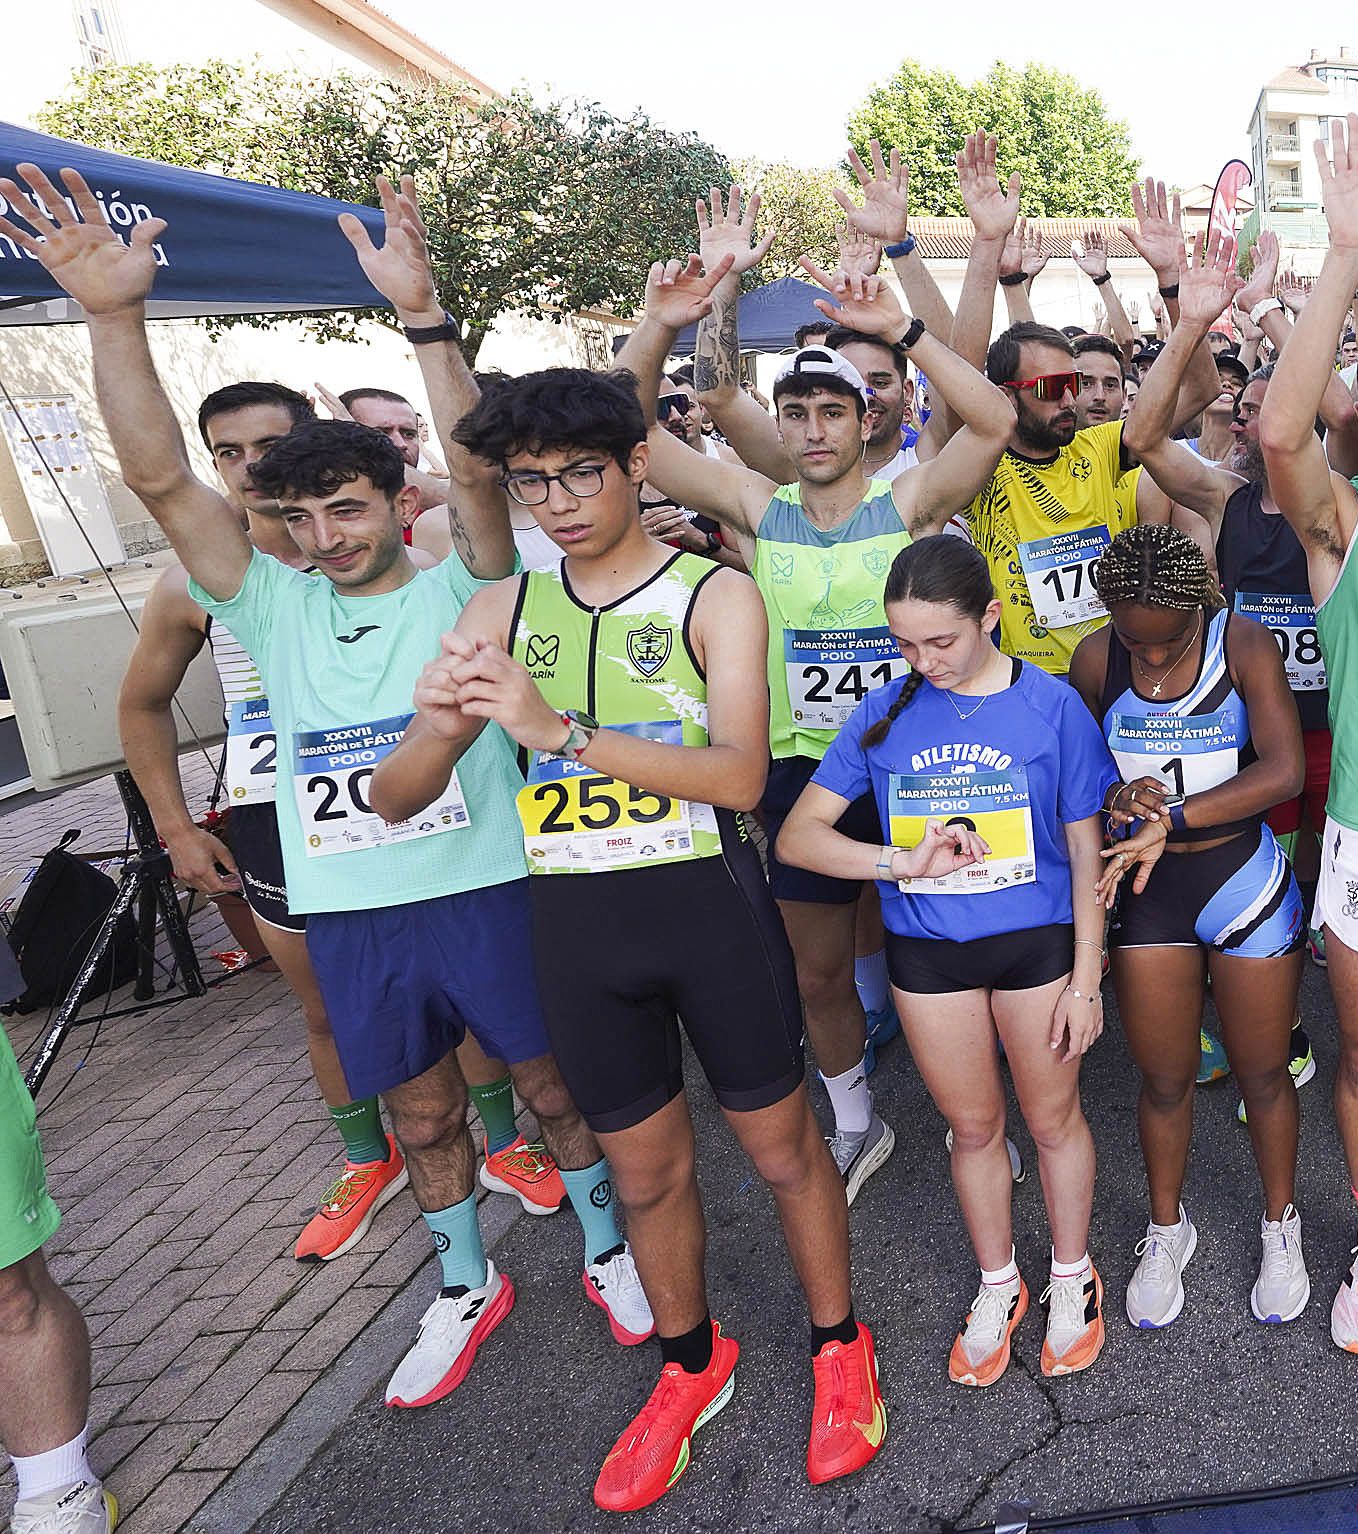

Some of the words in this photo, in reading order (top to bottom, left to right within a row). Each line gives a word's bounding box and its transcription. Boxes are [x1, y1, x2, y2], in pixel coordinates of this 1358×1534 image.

[1051, 534, 1079, 546] XXXVII
[1029, 545, 1066, 560] MARATÓN
[1074, 536, 1104, 549] FÁTIMA
[1054, 552, 1081, 564] POIO
[1240, 604, 1274, 613] MARATÓN
[1284, 604, 1315, 614] FÁTIM
[1260, 615, 1290, 624] POIO
[820, 632, 856, 640] XXXVII
[793, 639, 837, 650] MARATÓN
[848, 637, 893, 649] FÁTIMA
[1269, 629, 1322, 664] 08
[820, 651, 855, 661] POIO
[802, 662, 895, 703] 241
[242, 710, 271, 721] MARA
[1144, 719, 1182, 729] XXXVII
[324, 727, 372, 741] XXXVII
[1118, 728, 1162, 739] MARATÓN
[1174, 726, 1223, 739] FÁTIMA
[298, 742, 349, 757] MARATÓN
[363, 730, 406, 748] FÁTI
[1145, 742, 1182, 752] POIO
[1205, 738, 1220, 746] 7.5
[328, 751, 376, 767] POIO
[911, 744, 1013, 772] ATLETISMO
[562, 762, 592, 774] PO
[929, 777, 970, 787] XXXVII
[1161, 758, 1184, 796] 1
[307, 767, 377, 822] 20
[898, 787, 948, 799] MARATÓN
[962, 783, 1014, 797] FÁTIMA
[533, 776, 673, 833] 255
[994, 795, 1010, 804] 7.5
[930, 800, 970, 812] POIO
[607, 837, 632, 848] FROIZ
[967, 869, 989, 878] FROIZ
